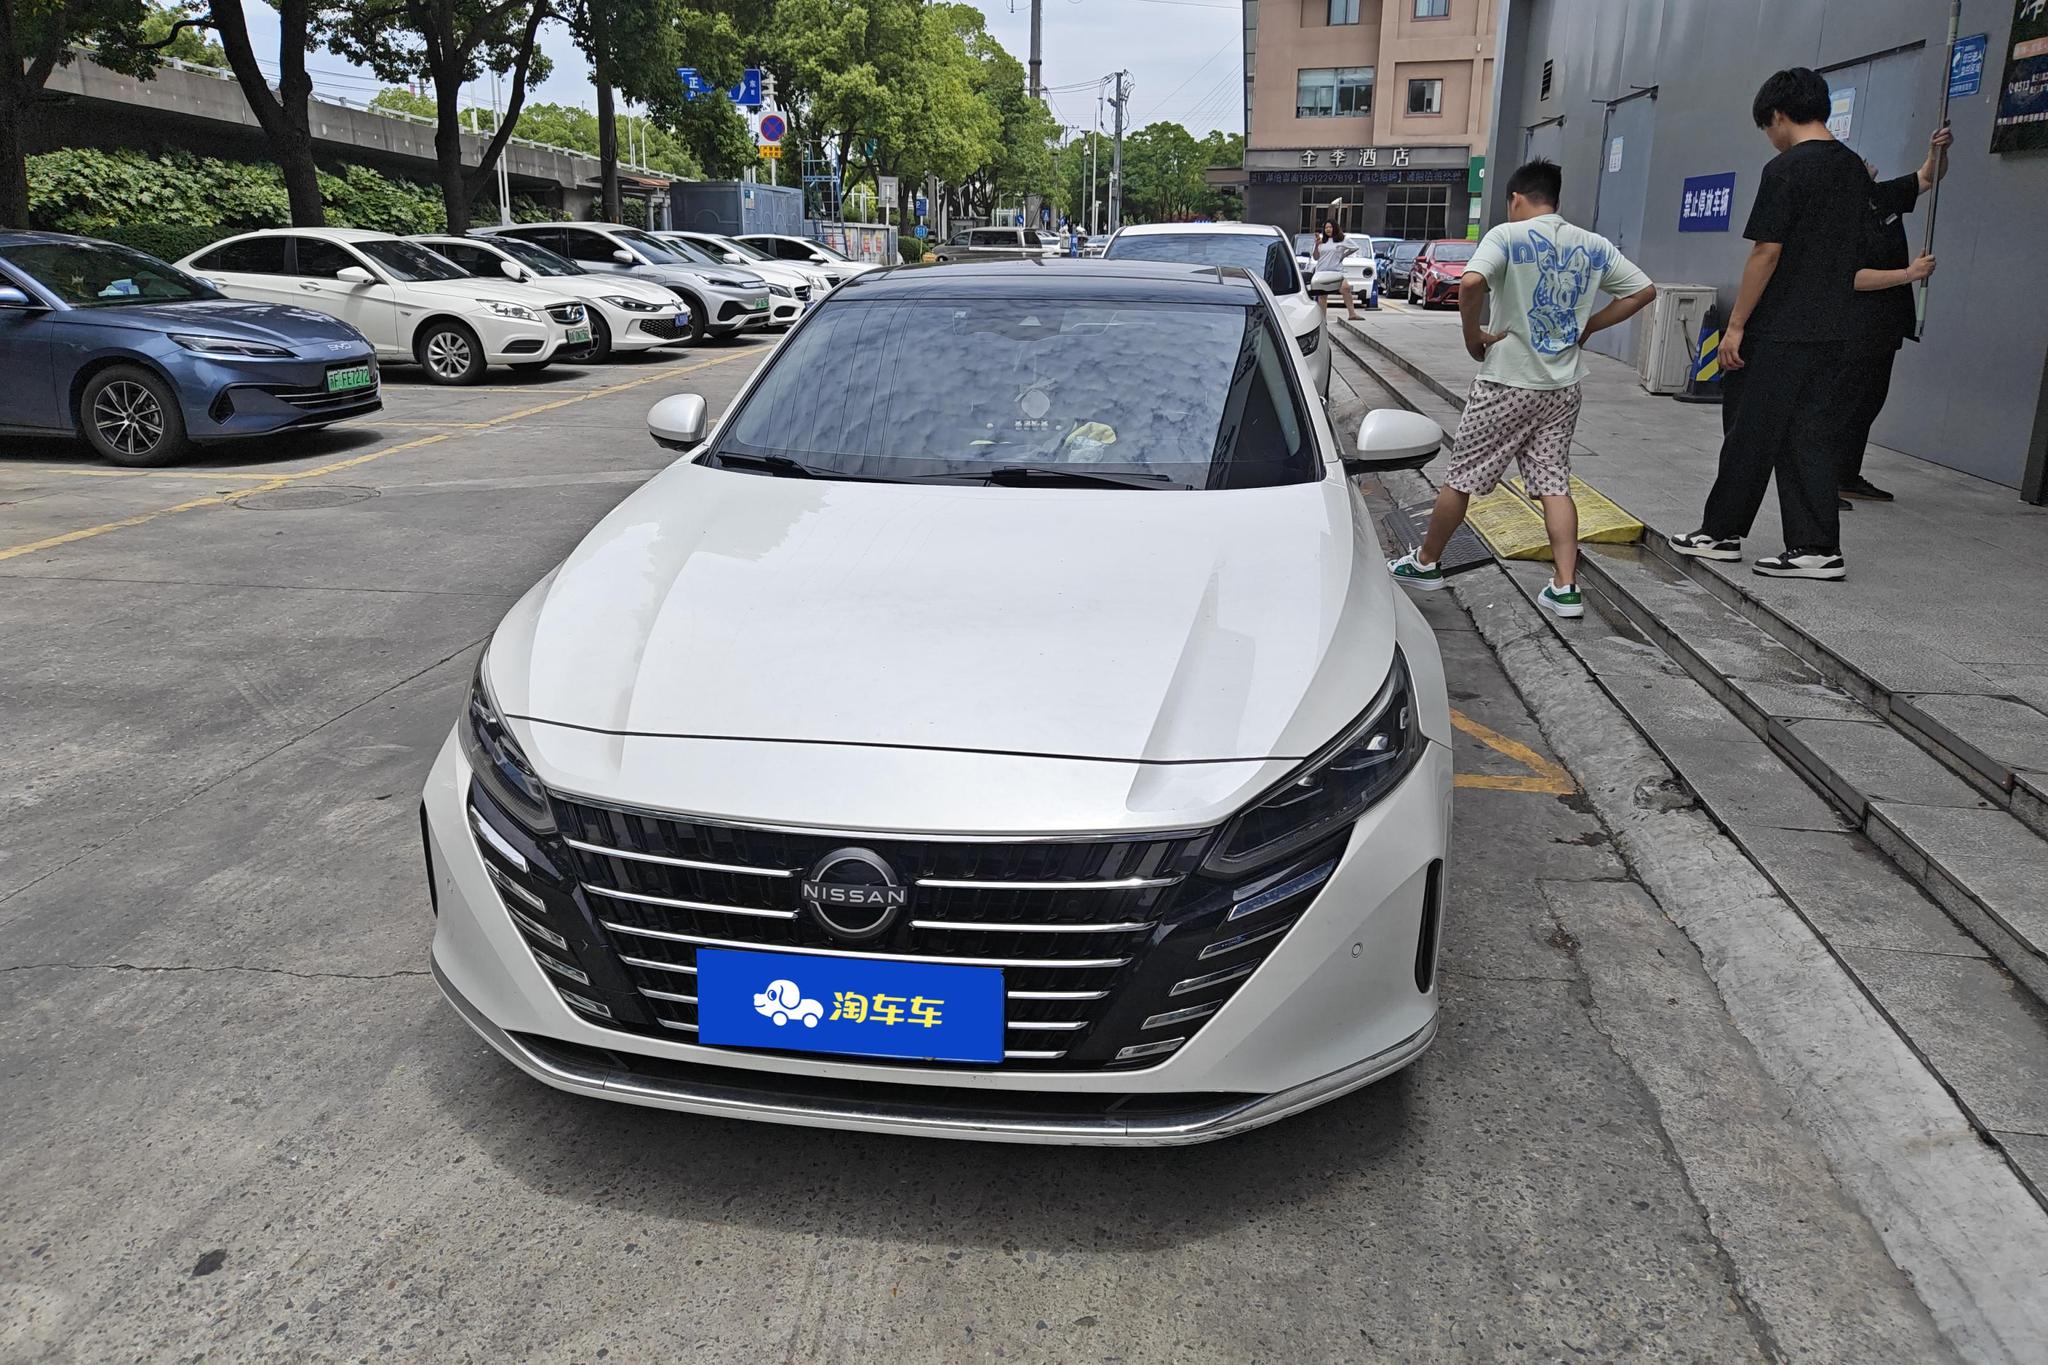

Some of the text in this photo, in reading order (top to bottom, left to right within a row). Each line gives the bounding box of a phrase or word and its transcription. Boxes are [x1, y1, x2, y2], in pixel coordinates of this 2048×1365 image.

[1302, 148, 1410, 168] 全季酒店
[1683, 187, 1730, 218] 禁止停放车辆
[803, 883, 905, 904] NISSAN
